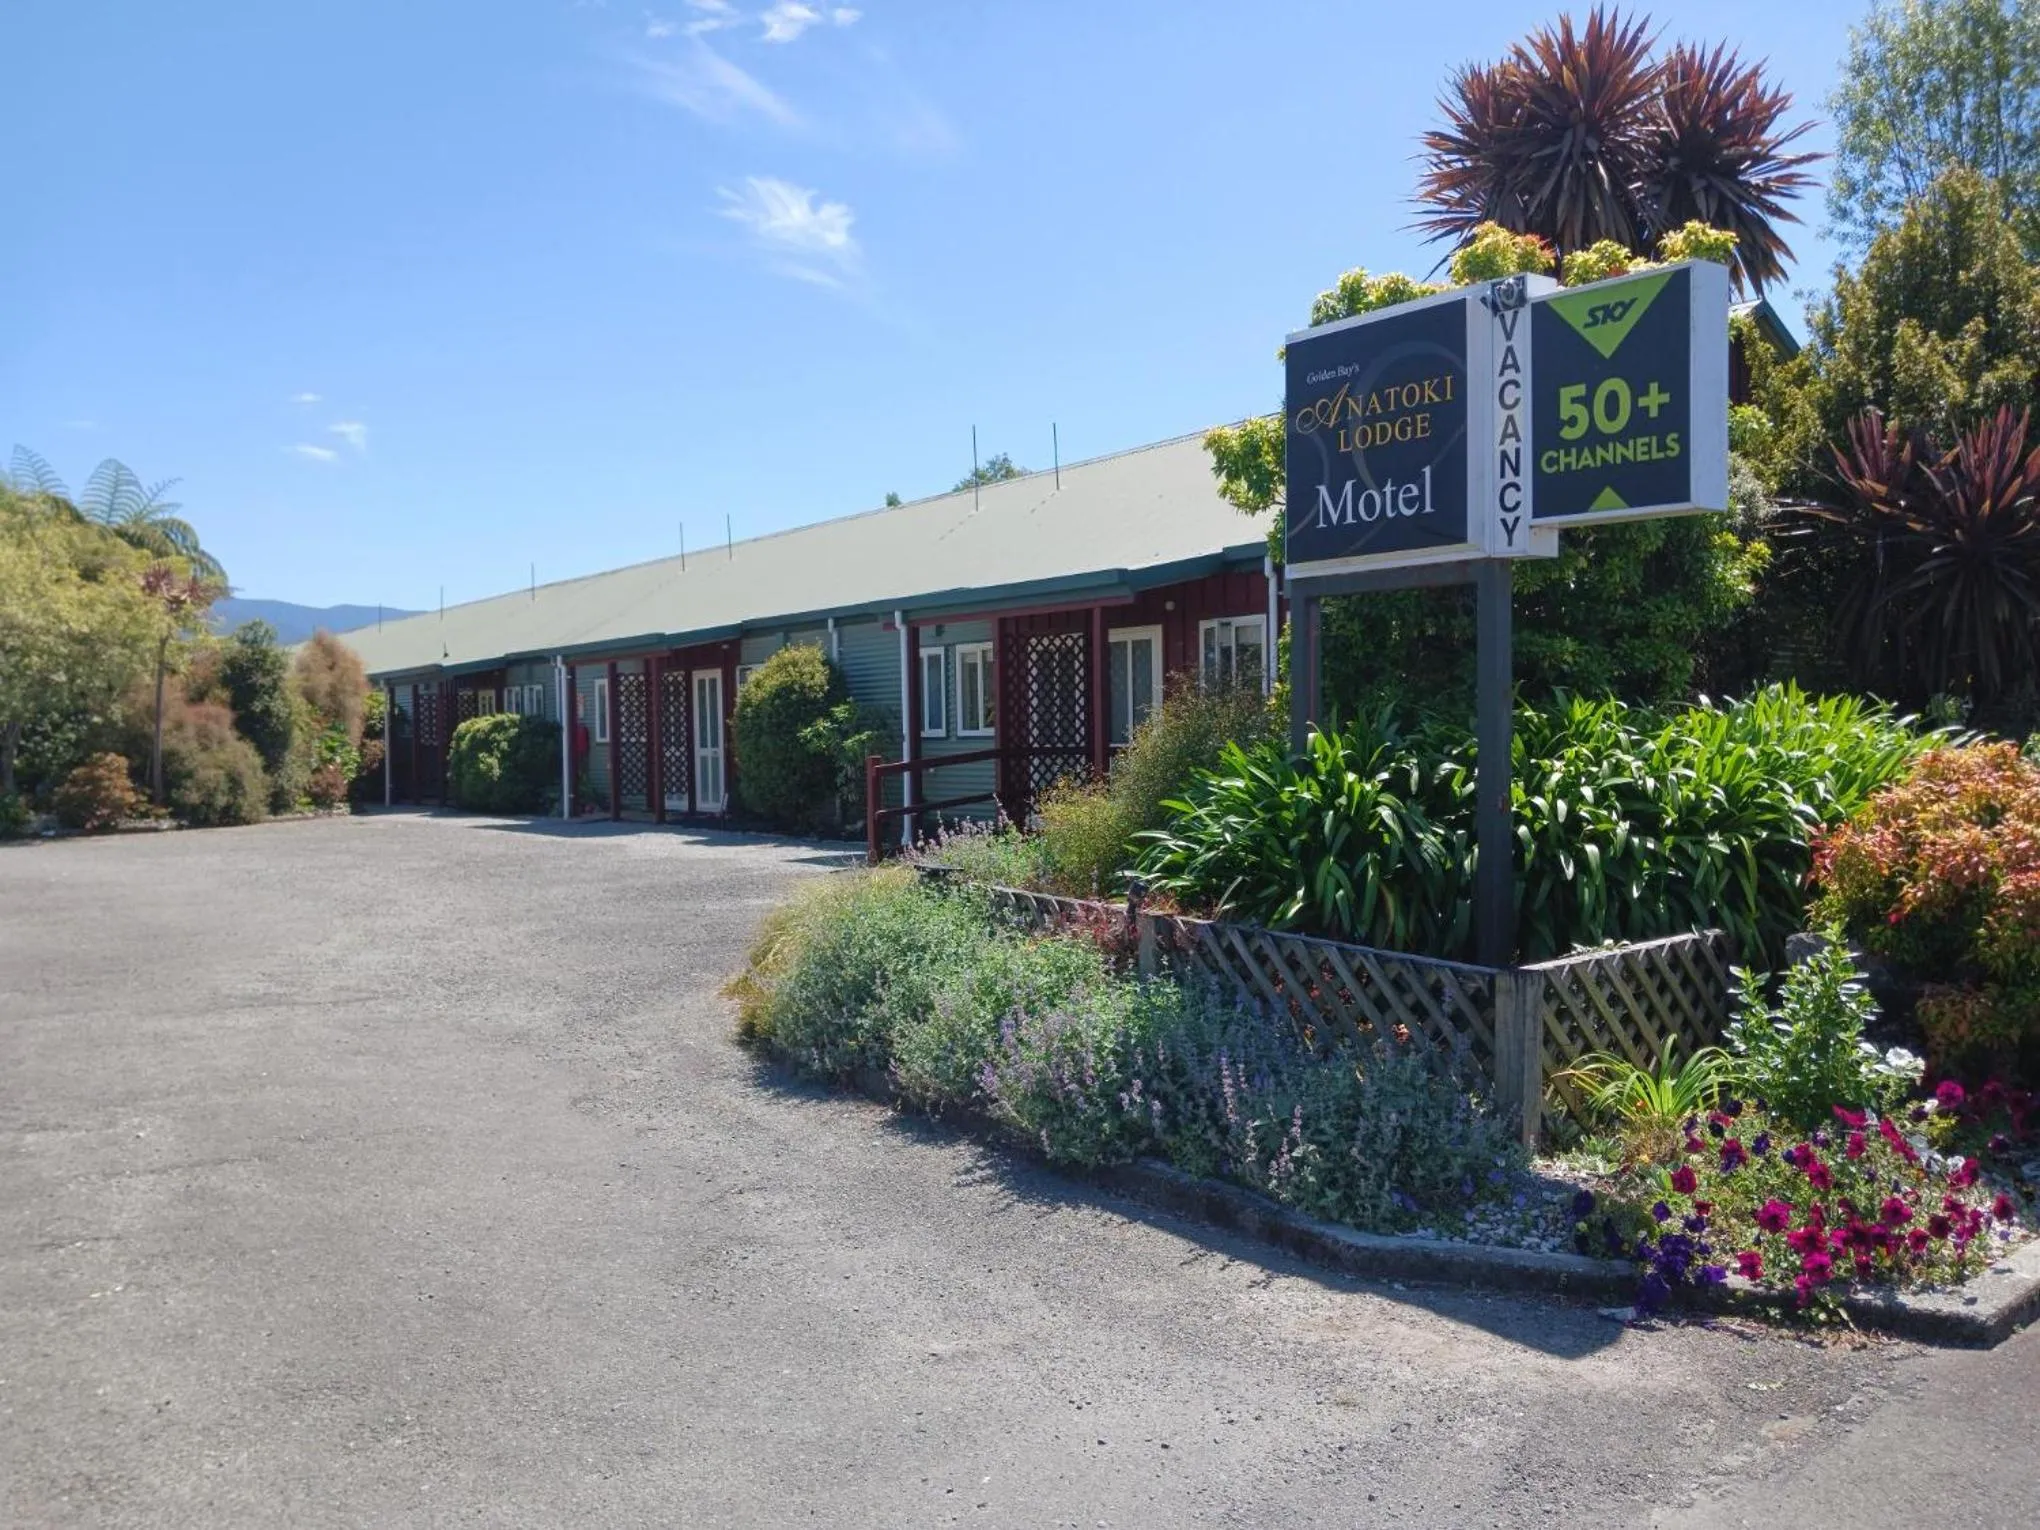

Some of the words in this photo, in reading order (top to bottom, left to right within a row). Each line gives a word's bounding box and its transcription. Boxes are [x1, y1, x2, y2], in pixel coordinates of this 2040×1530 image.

[1584, 297, 1638, 329] SKY
[1306, 369, 1336, 385] Golden
[1337, 362, 1360, 378] Bay's
[1296, 375, 1454, 435] ANATOKI
[1498, 310, 1521, 547] VACANCY
[1559, 377, 1670, 440] 50+
[1338, 413, 1431, 453] LODGE
[1541, 432, 1680, 475] CHANNELS
[1316, 465, 1435, 529] Motel
